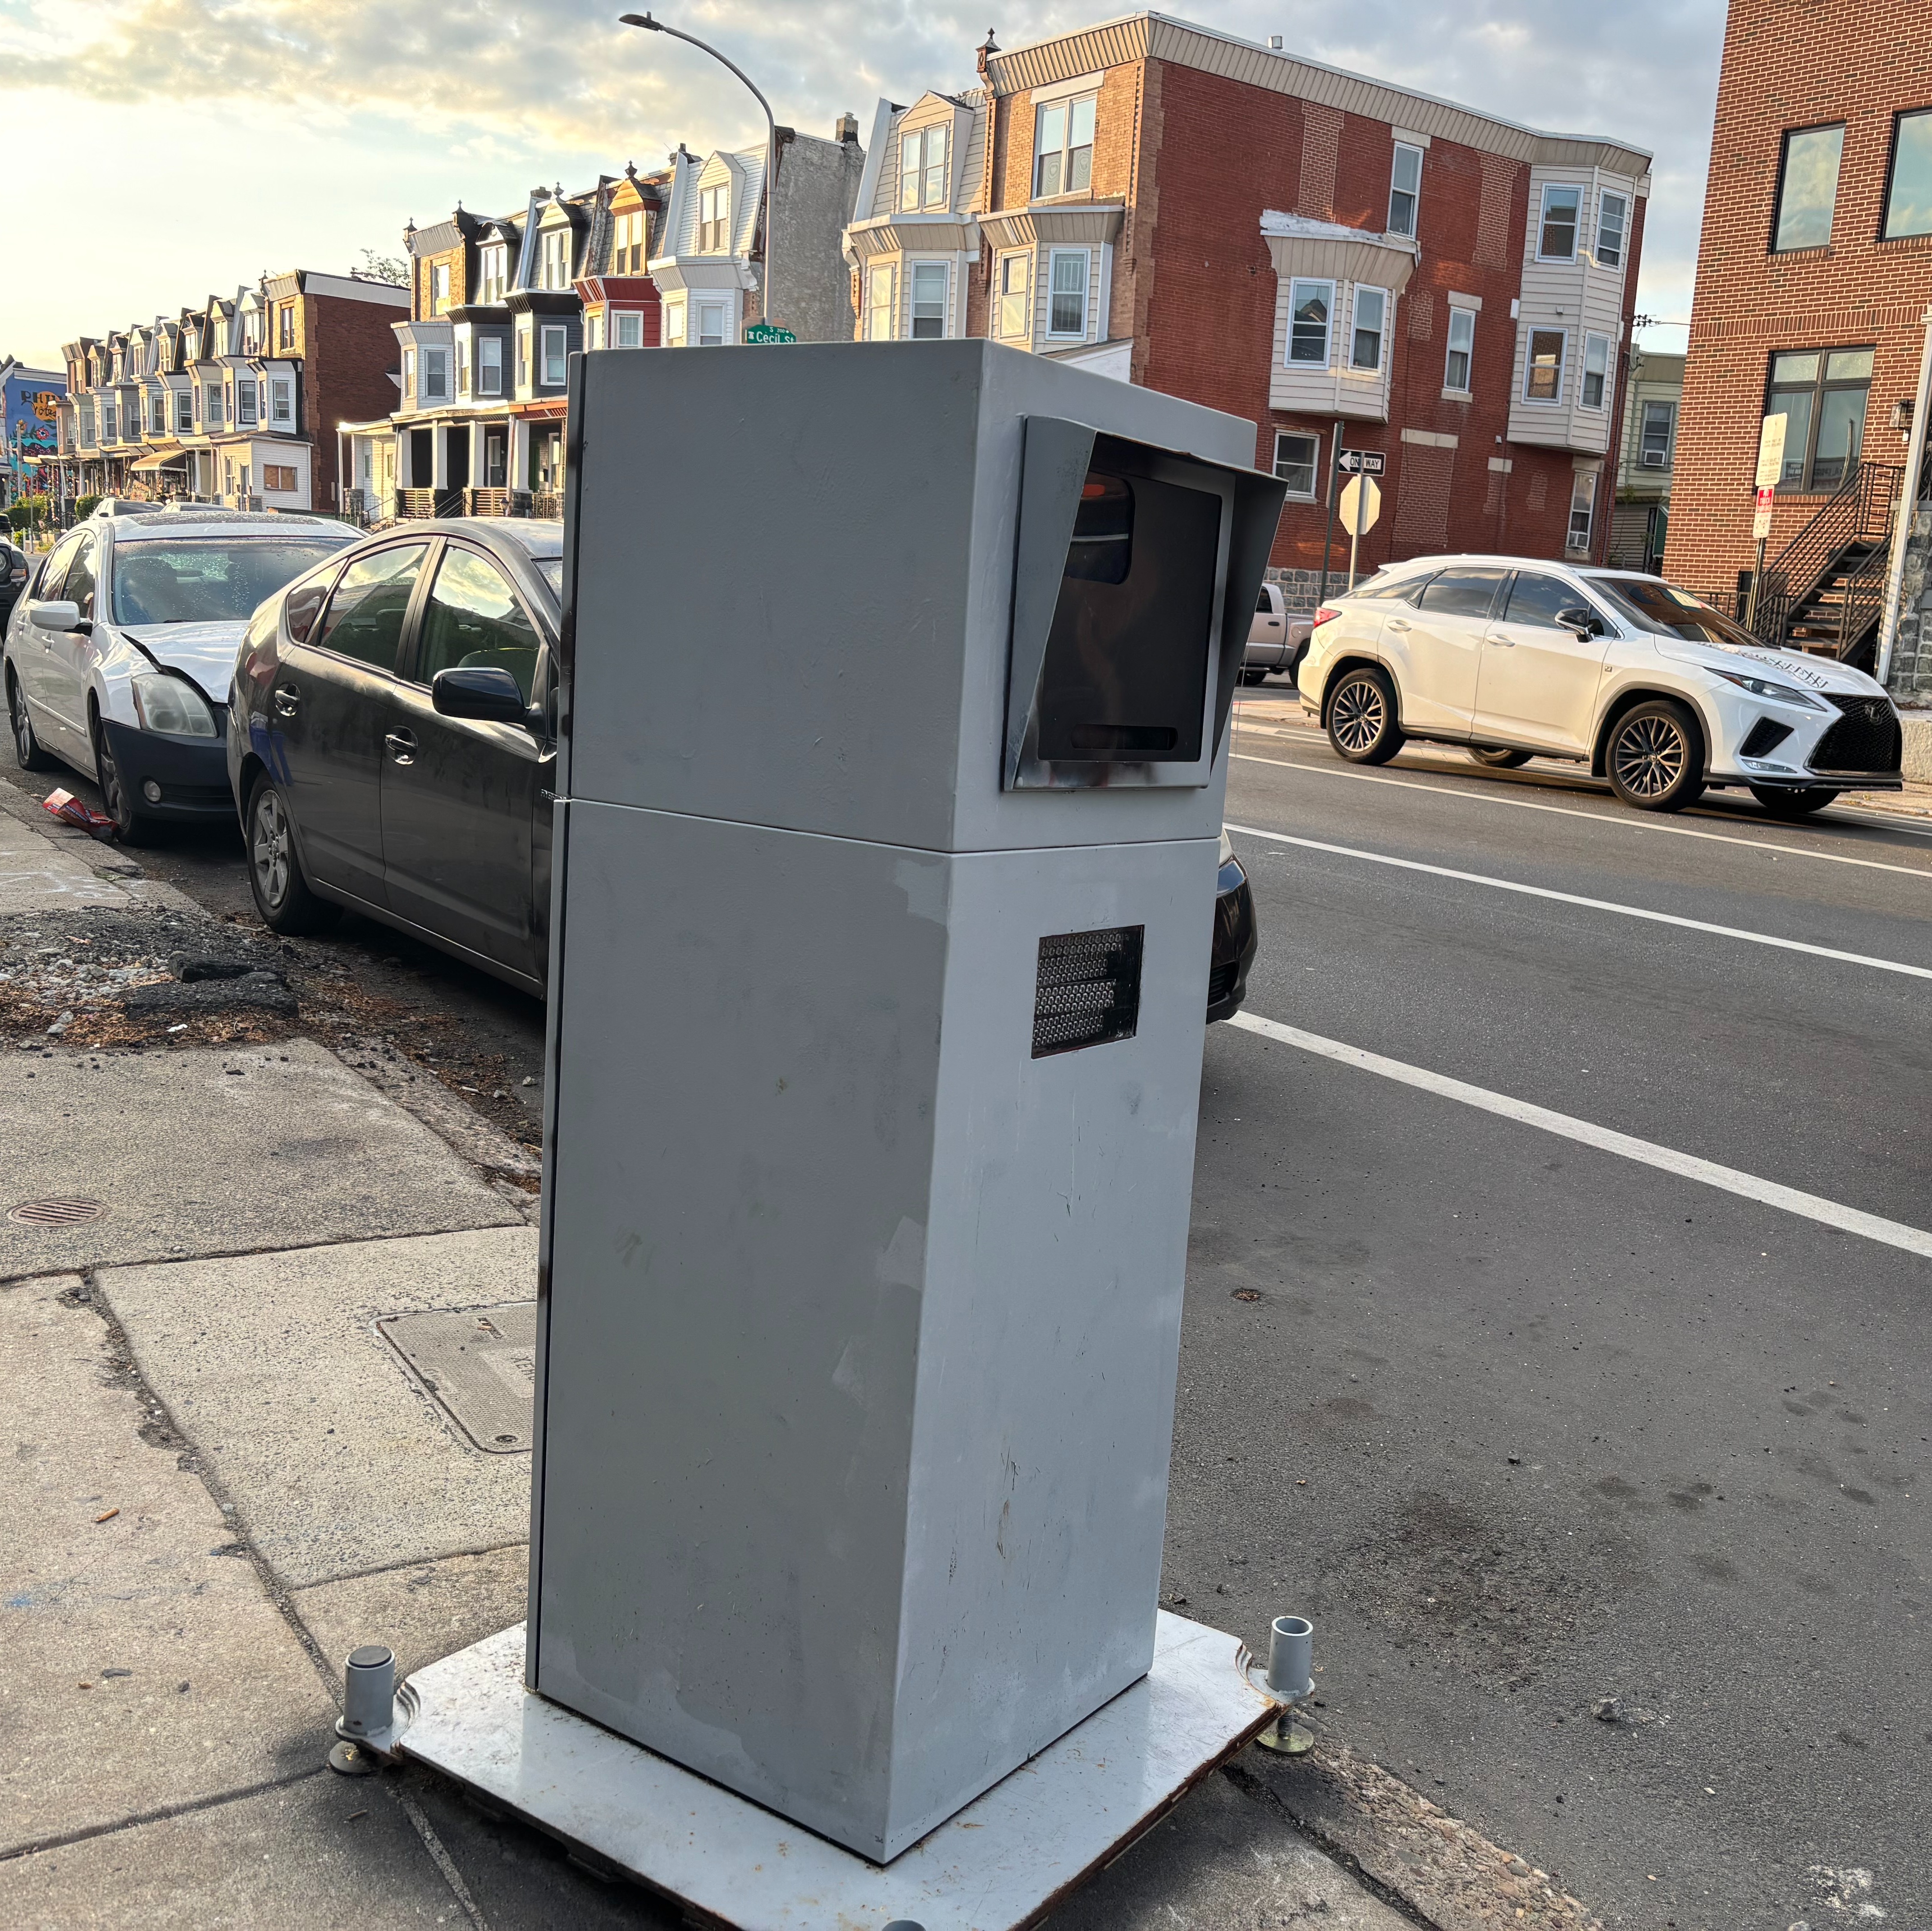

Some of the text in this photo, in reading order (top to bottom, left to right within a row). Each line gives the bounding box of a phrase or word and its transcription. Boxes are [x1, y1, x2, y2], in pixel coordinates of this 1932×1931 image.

[756, 331, 780, 343] Cecil
[1350, 458, 1379, 468] ON WAY
